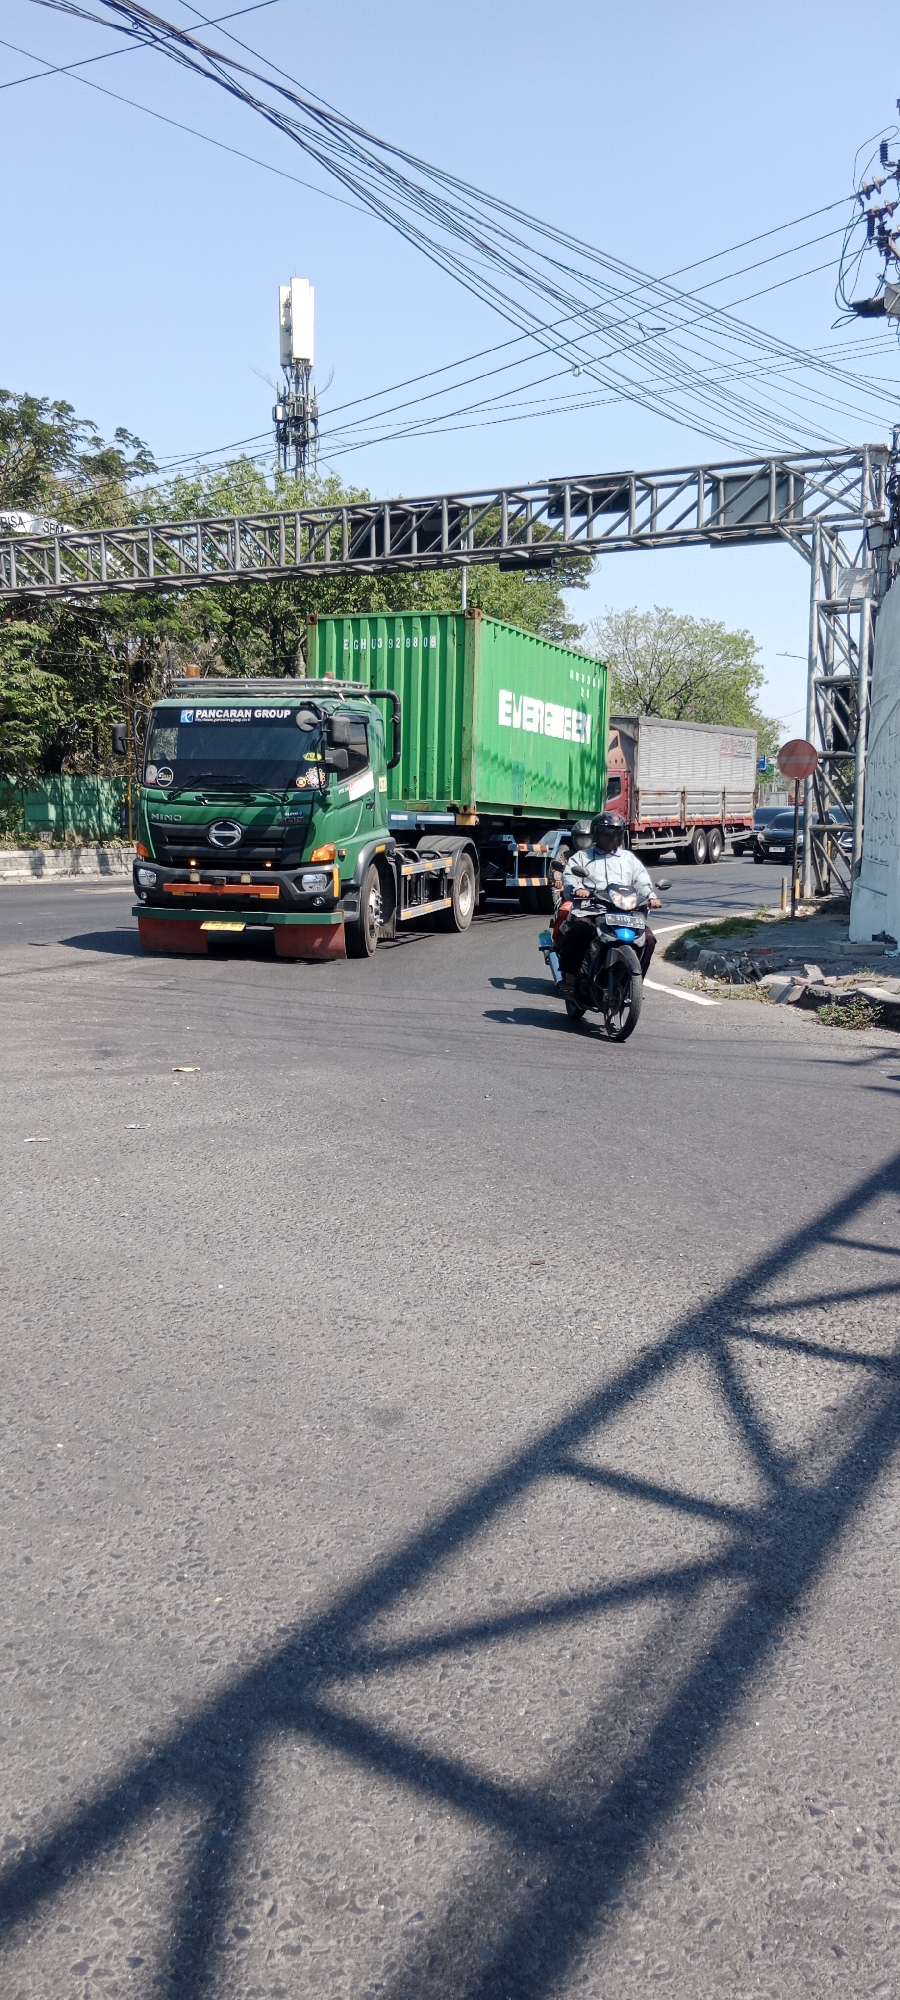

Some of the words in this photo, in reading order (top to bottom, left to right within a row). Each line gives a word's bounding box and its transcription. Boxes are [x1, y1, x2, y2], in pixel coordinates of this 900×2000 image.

[195, 709, 252, 719] PANCARAN
[254, 709, 291, 719] GROUP
[498, 689, 592, 745] EVERGREEN
[151, 813, 182, 822] HINO
